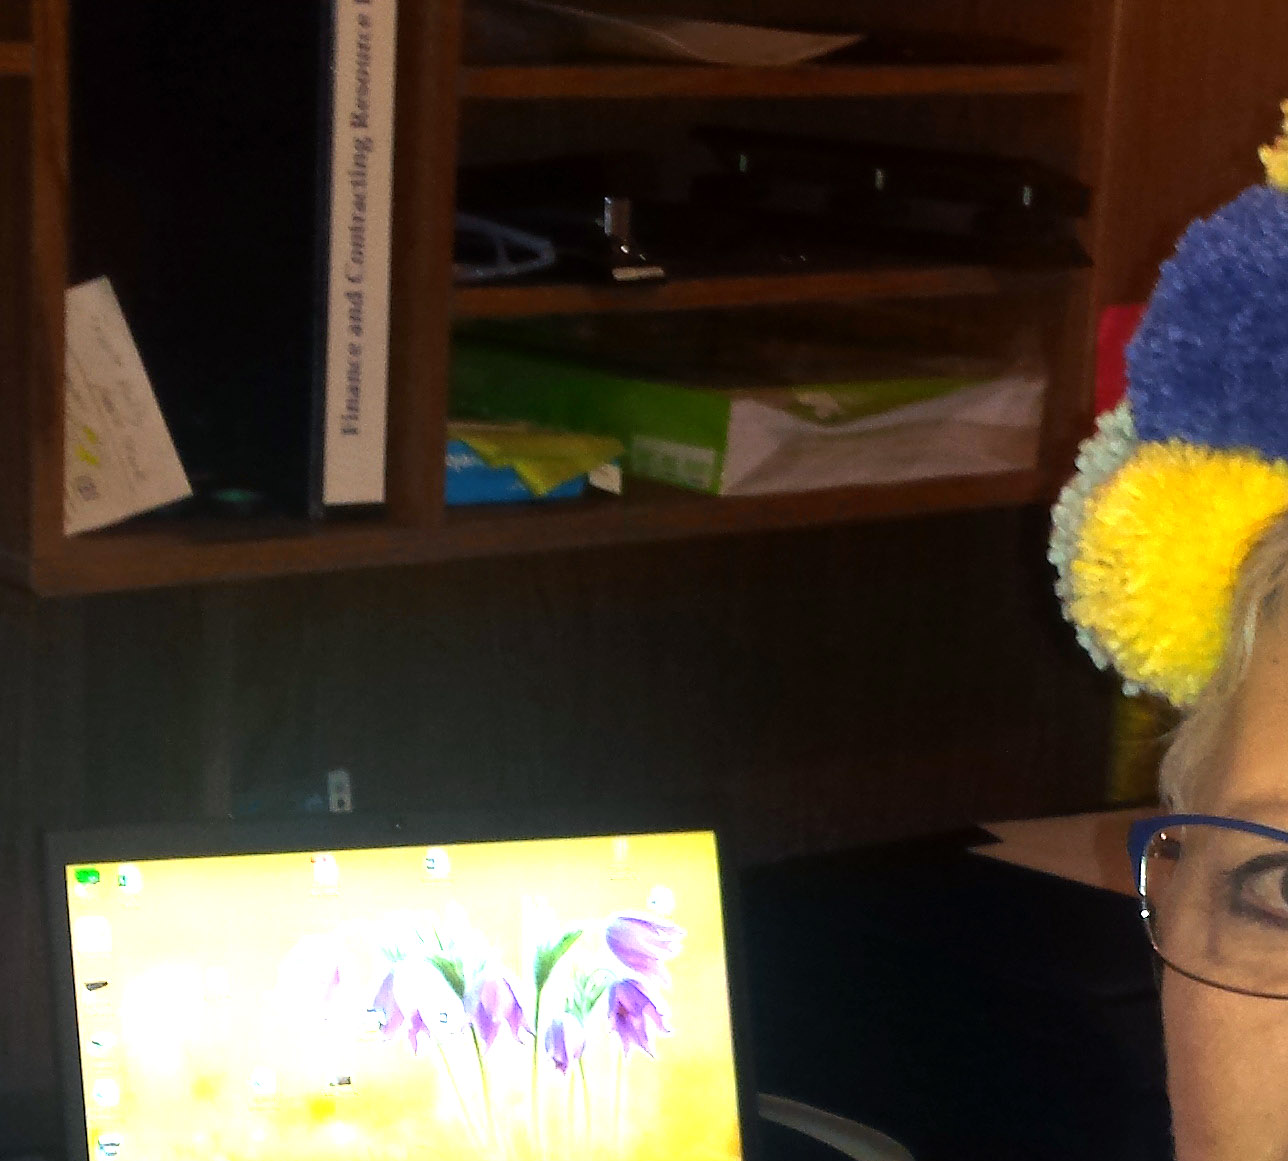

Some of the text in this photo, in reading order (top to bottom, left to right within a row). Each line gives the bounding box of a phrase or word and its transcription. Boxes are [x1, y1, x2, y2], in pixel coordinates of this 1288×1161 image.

[340, 14, 374, 436] Finance and Contracting Resource
